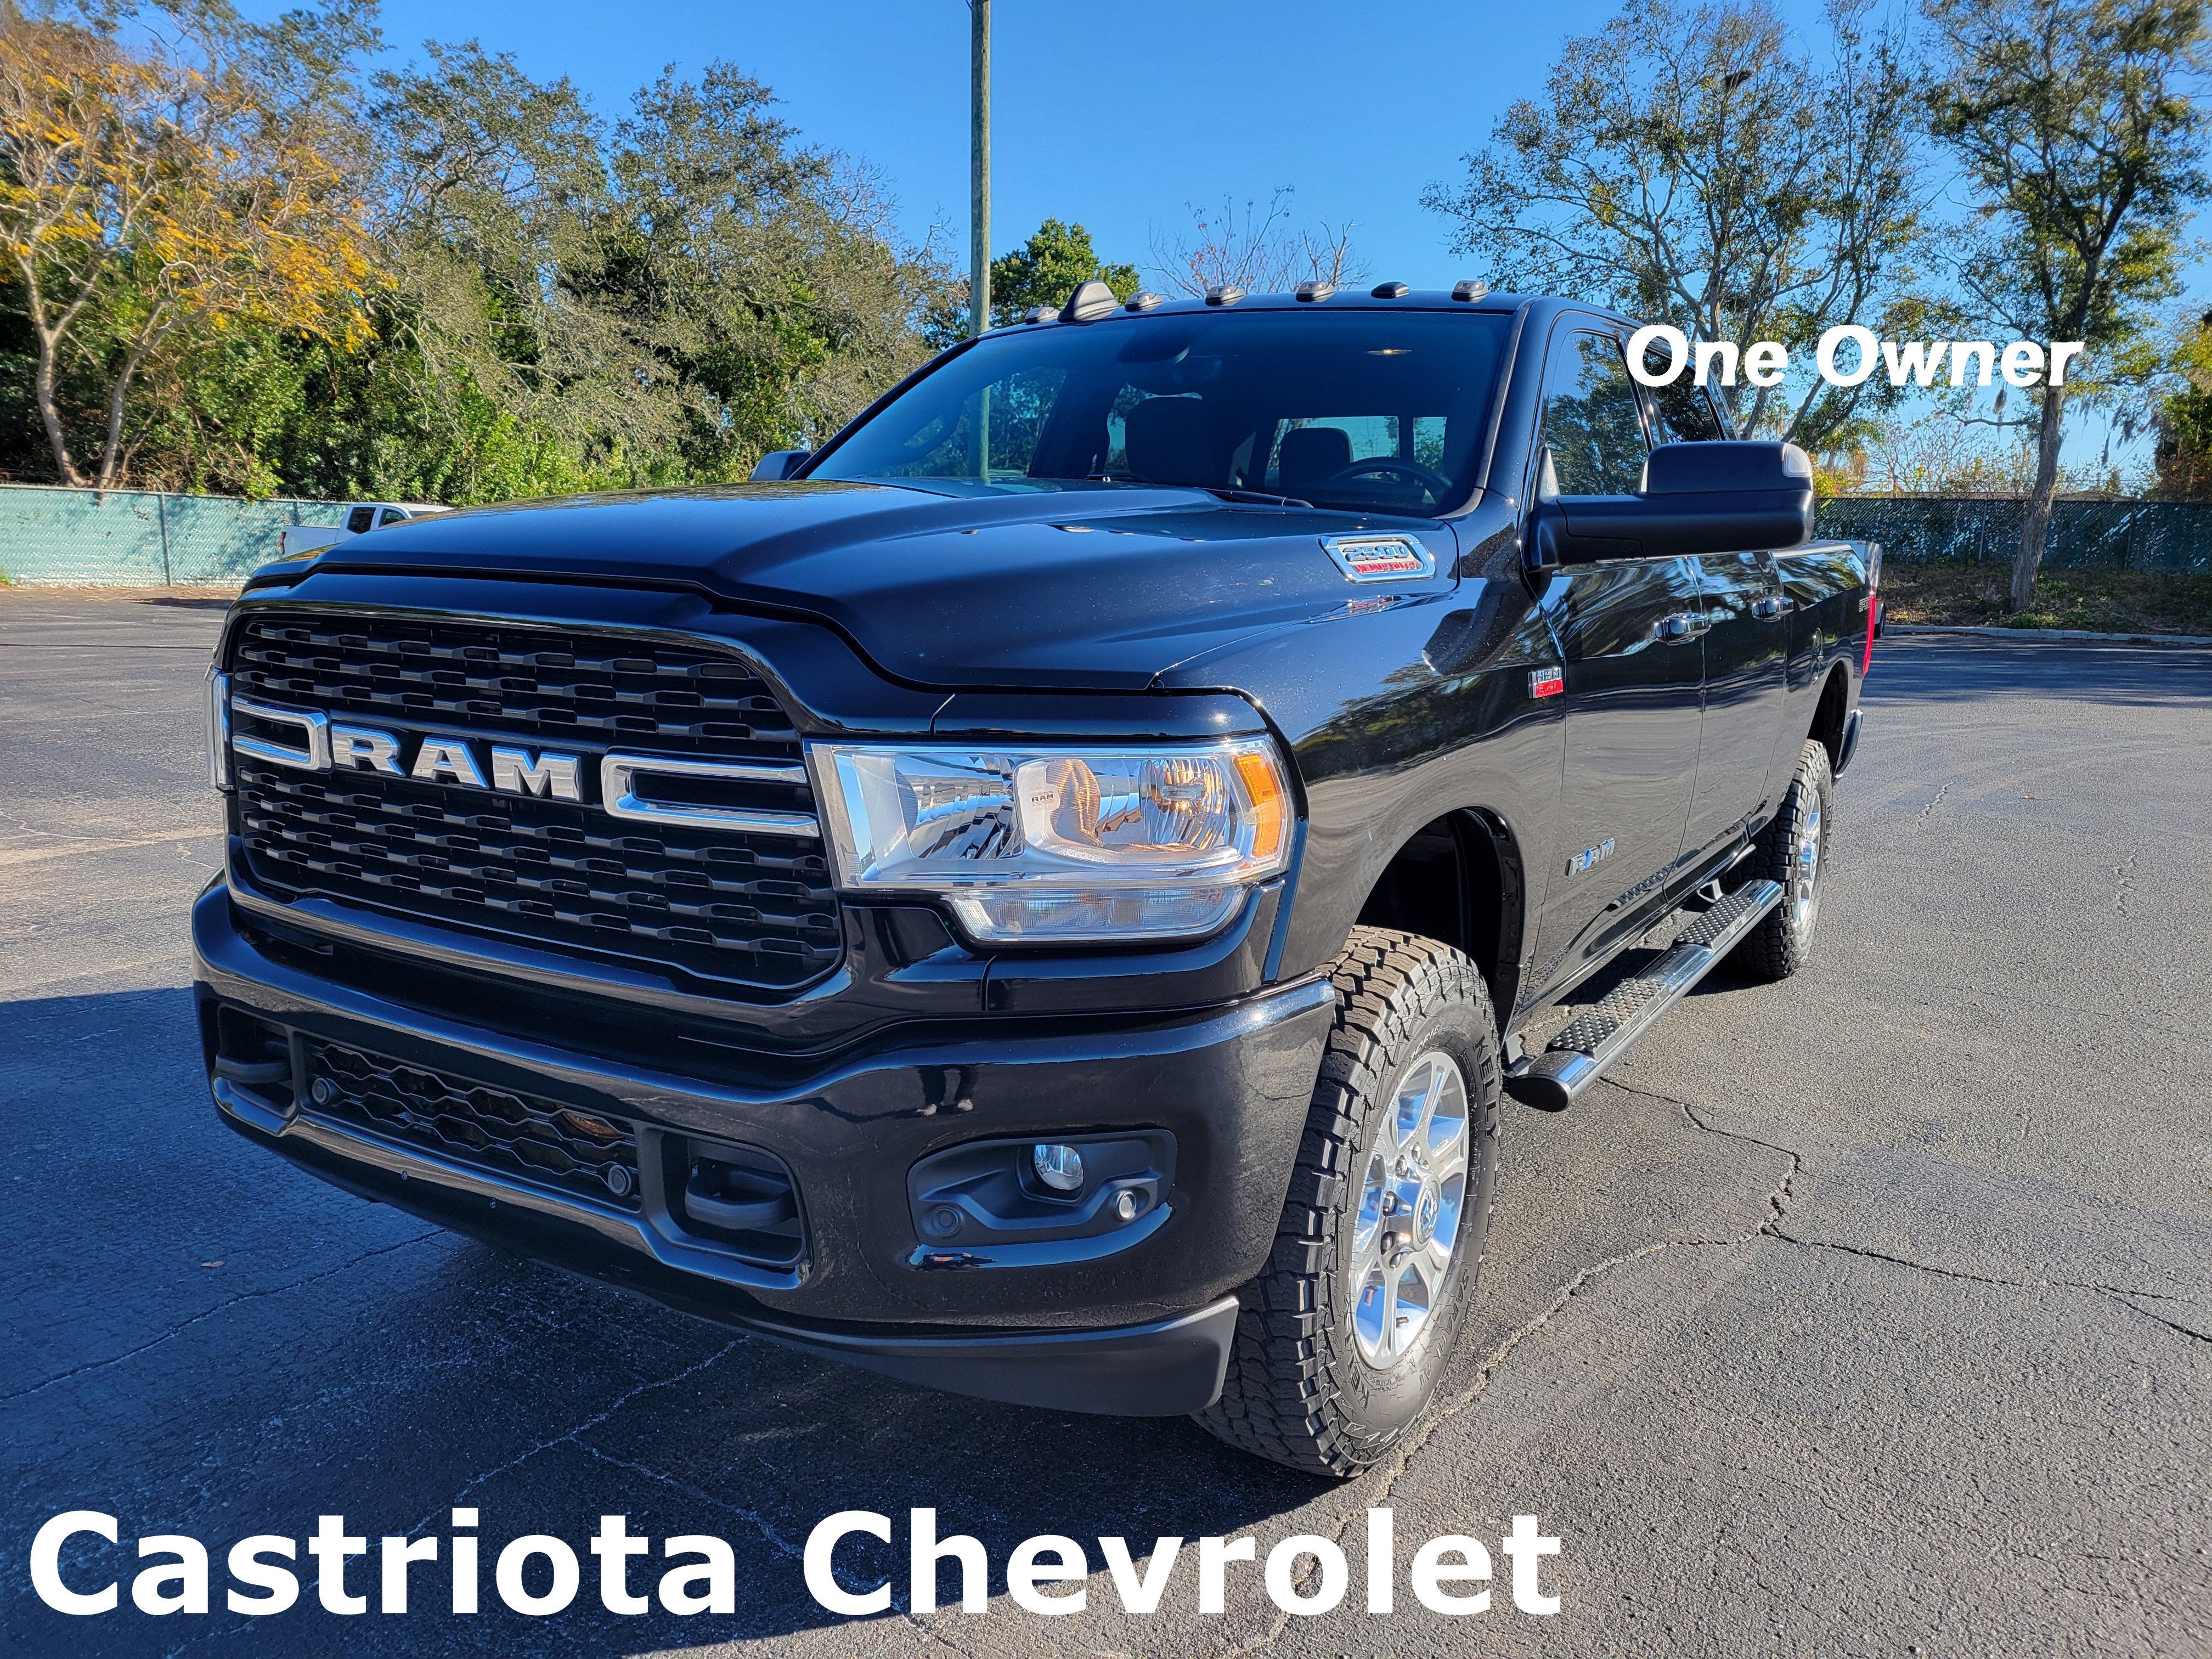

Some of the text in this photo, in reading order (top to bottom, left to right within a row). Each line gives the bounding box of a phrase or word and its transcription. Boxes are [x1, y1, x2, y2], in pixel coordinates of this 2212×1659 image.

[1342, 545, 1409, 561] 2500
[1355, 561, 1417, 573] HEAVY DUTY
[330, 723, 584, 802] RAM
[1031, 793, 1053, 802] RAM
[1567, 838, 1615, 876] RAM
[1473, 1034, 1497, 1146] KELLY
